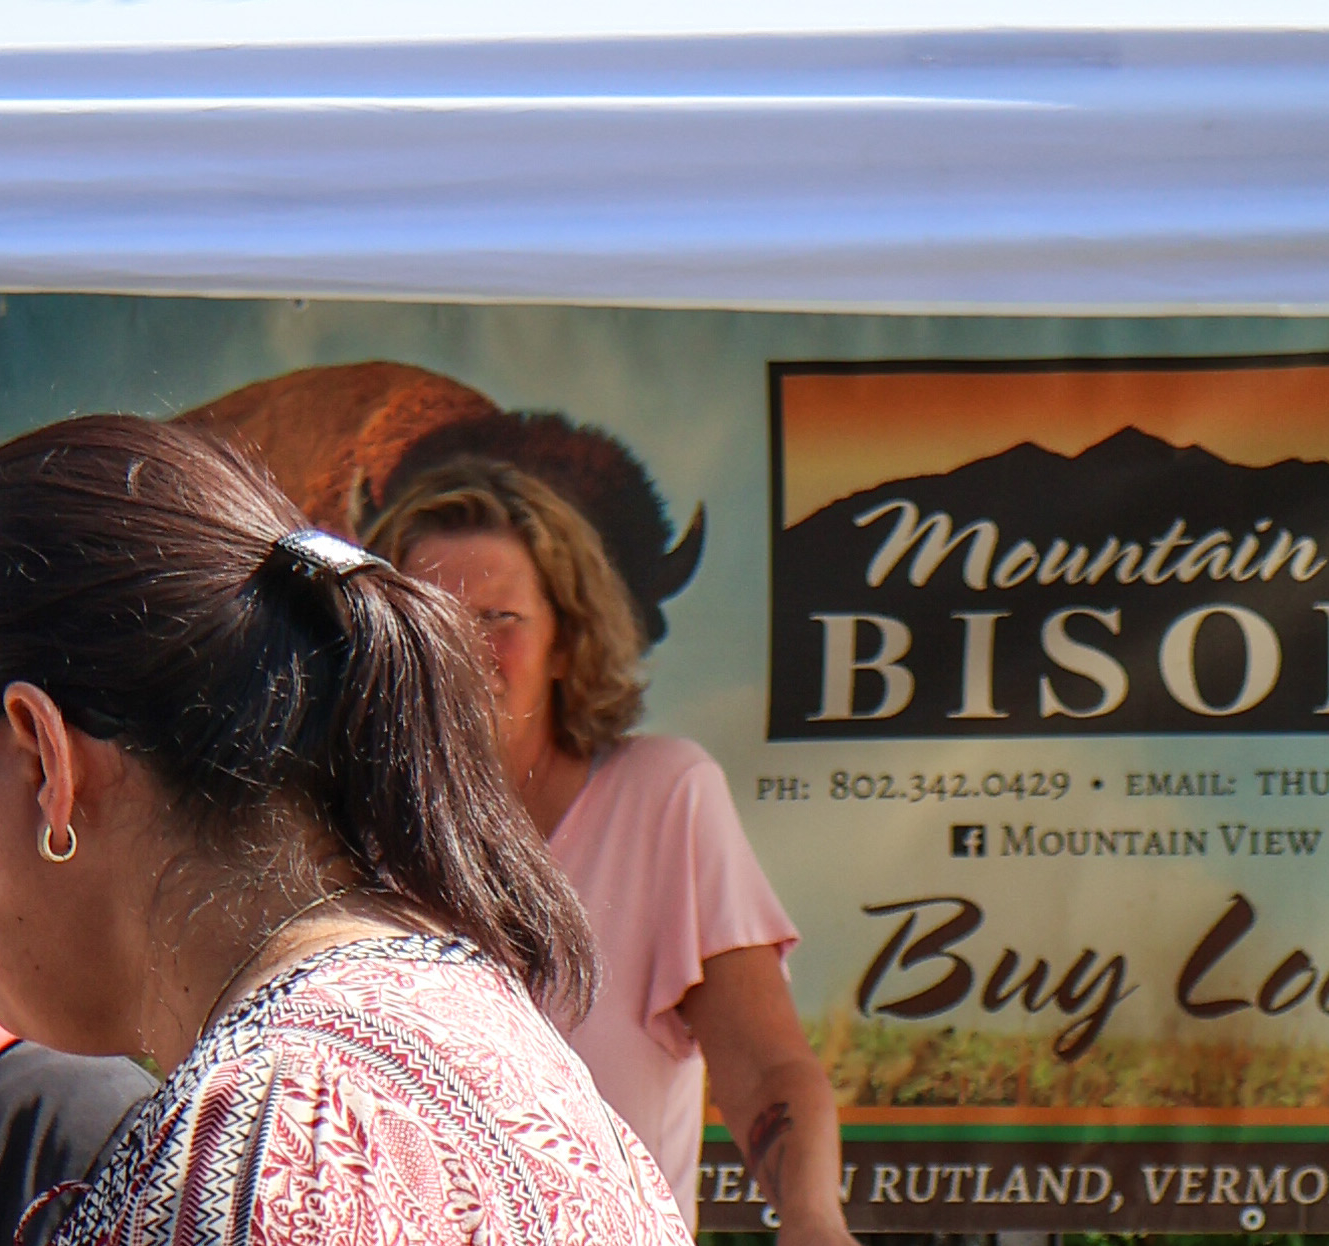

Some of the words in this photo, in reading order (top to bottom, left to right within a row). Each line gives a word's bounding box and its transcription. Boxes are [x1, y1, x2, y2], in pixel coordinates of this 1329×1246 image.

[852, 498, 1327, 590] Mountain
[805, 603, 1329, 722] BISO
[757, 777, 810, 802] PH:
[829, 769, 1071, 805] 802.342.0429
[1126, 770, 1238, 797] EMAIL:
[999, 824, 1209, 858] MOUNTAIN
[1217, 821, 1323, 857] VIEW
[855, 895, 1141, 1063] Buy
[1175, 892, 1329, 1021] Lo
[868, 1162, 1126, 1214] RUTLAND,
[1140, 1162, 1329, 1206] VERMO
